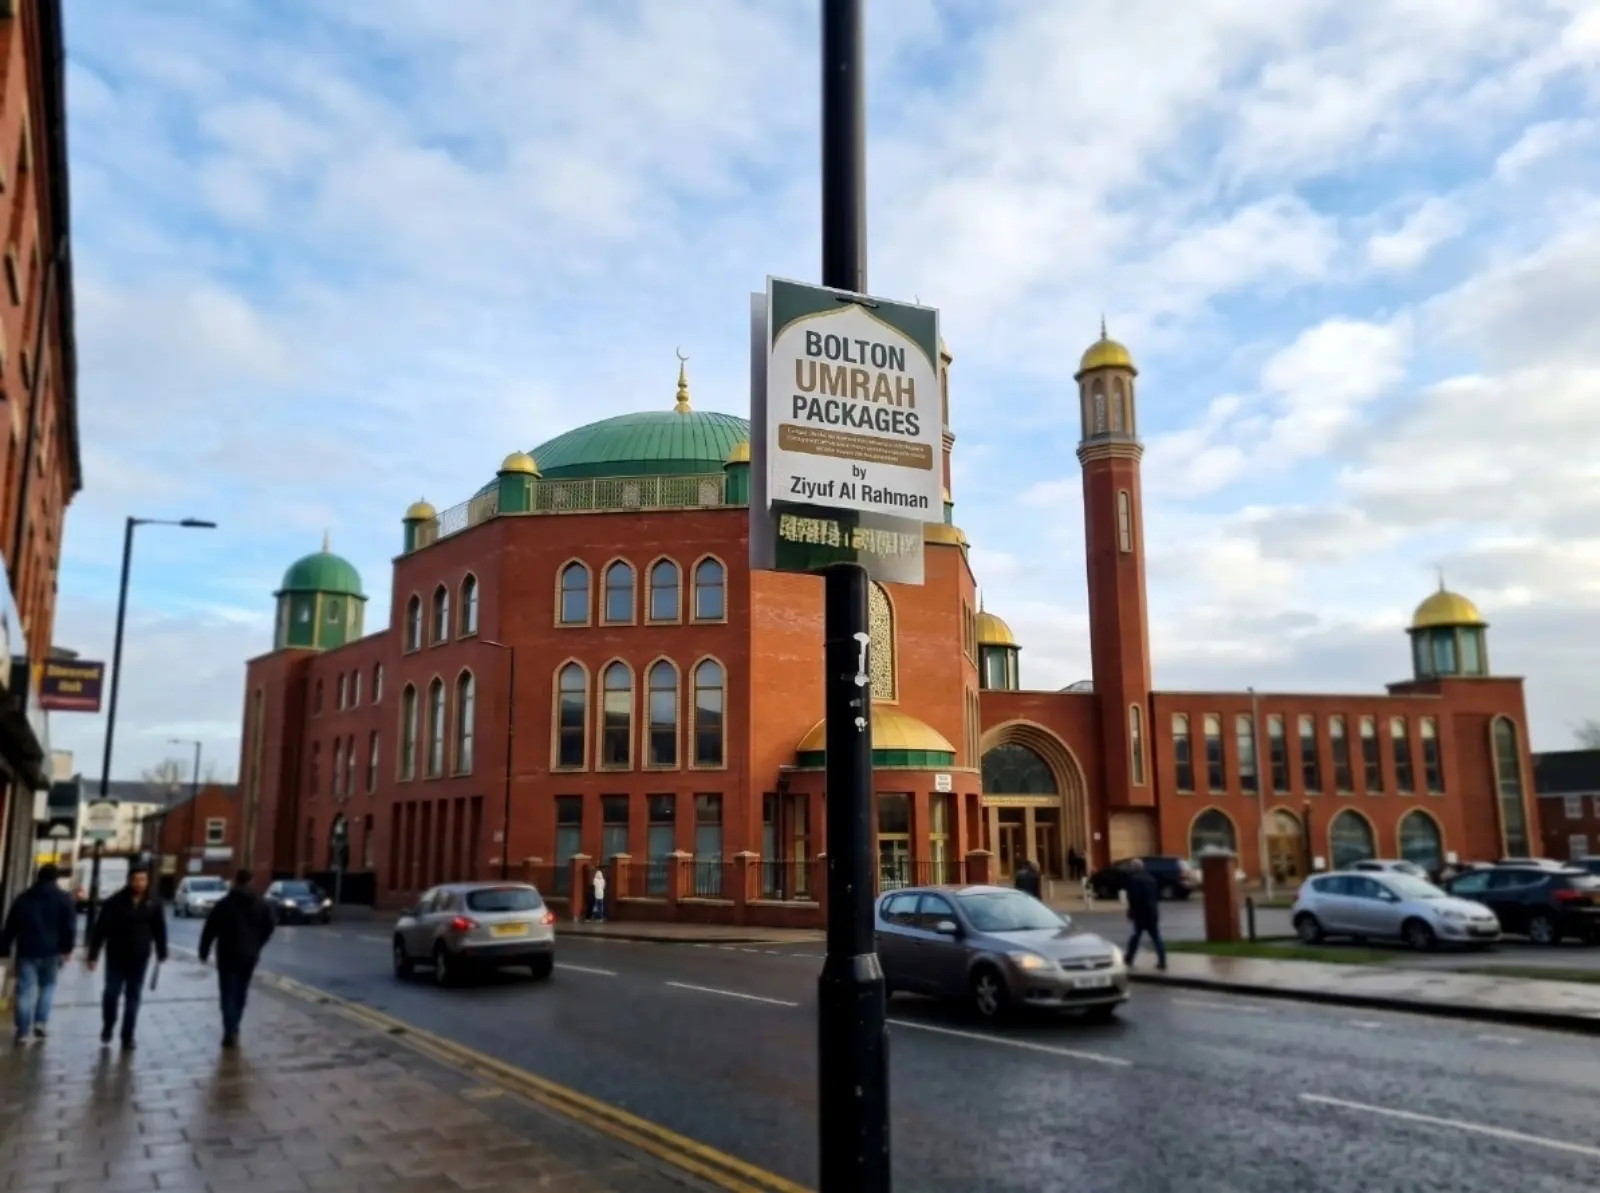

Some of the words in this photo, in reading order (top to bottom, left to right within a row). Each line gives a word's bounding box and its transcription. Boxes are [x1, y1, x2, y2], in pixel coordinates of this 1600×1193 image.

[806, 330, 905, 372] BOLTON
[795, 358, 916, 409] UMRAH
[792, 394, 920, 436] PACKAGES
[790, 475, 834, 499] Ziyuf
[839, 481, 856, 500] Al
[861, 484, 929, 508] Rahman
[852, 465, 867, 481] by
